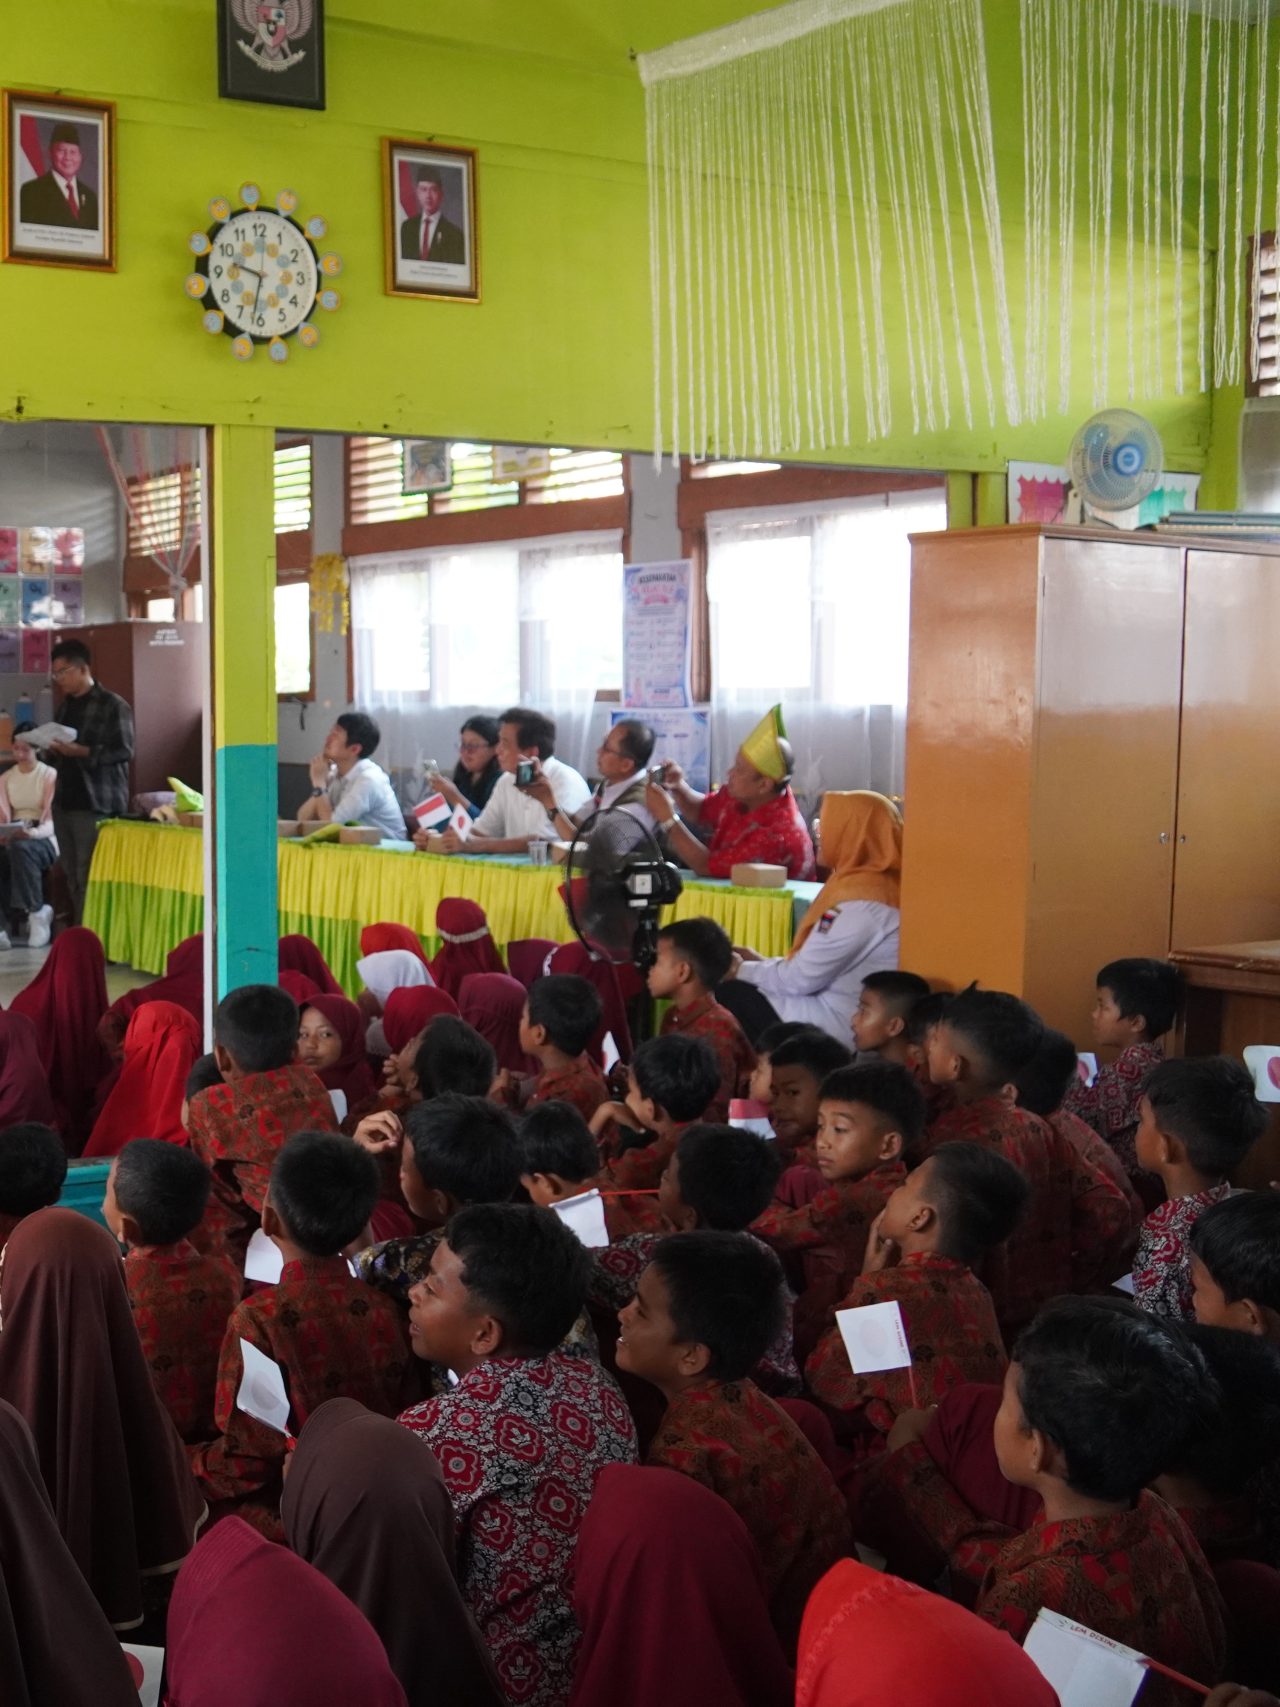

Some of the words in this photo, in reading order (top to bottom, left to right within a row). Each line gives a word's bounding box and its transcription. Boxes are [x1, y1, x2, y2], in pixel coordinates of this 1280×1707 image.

[234, 228, 246, 241] 11
[253, 223, 266, 237] 12
[277, 232, 283, 245] 1
[220, 243, 234, 257] 10
[291, 249, 299, 263] 2
[214, 265, 223, 278] 9
[296, 271, 305, 285] 3
[222, 289, 230, 303] 8
[289, 295, 298, 308] 4
[237, 305, 244, 319] 7
[278, 308, 286, 322] 5
[257, 314, 265, 327] 6
